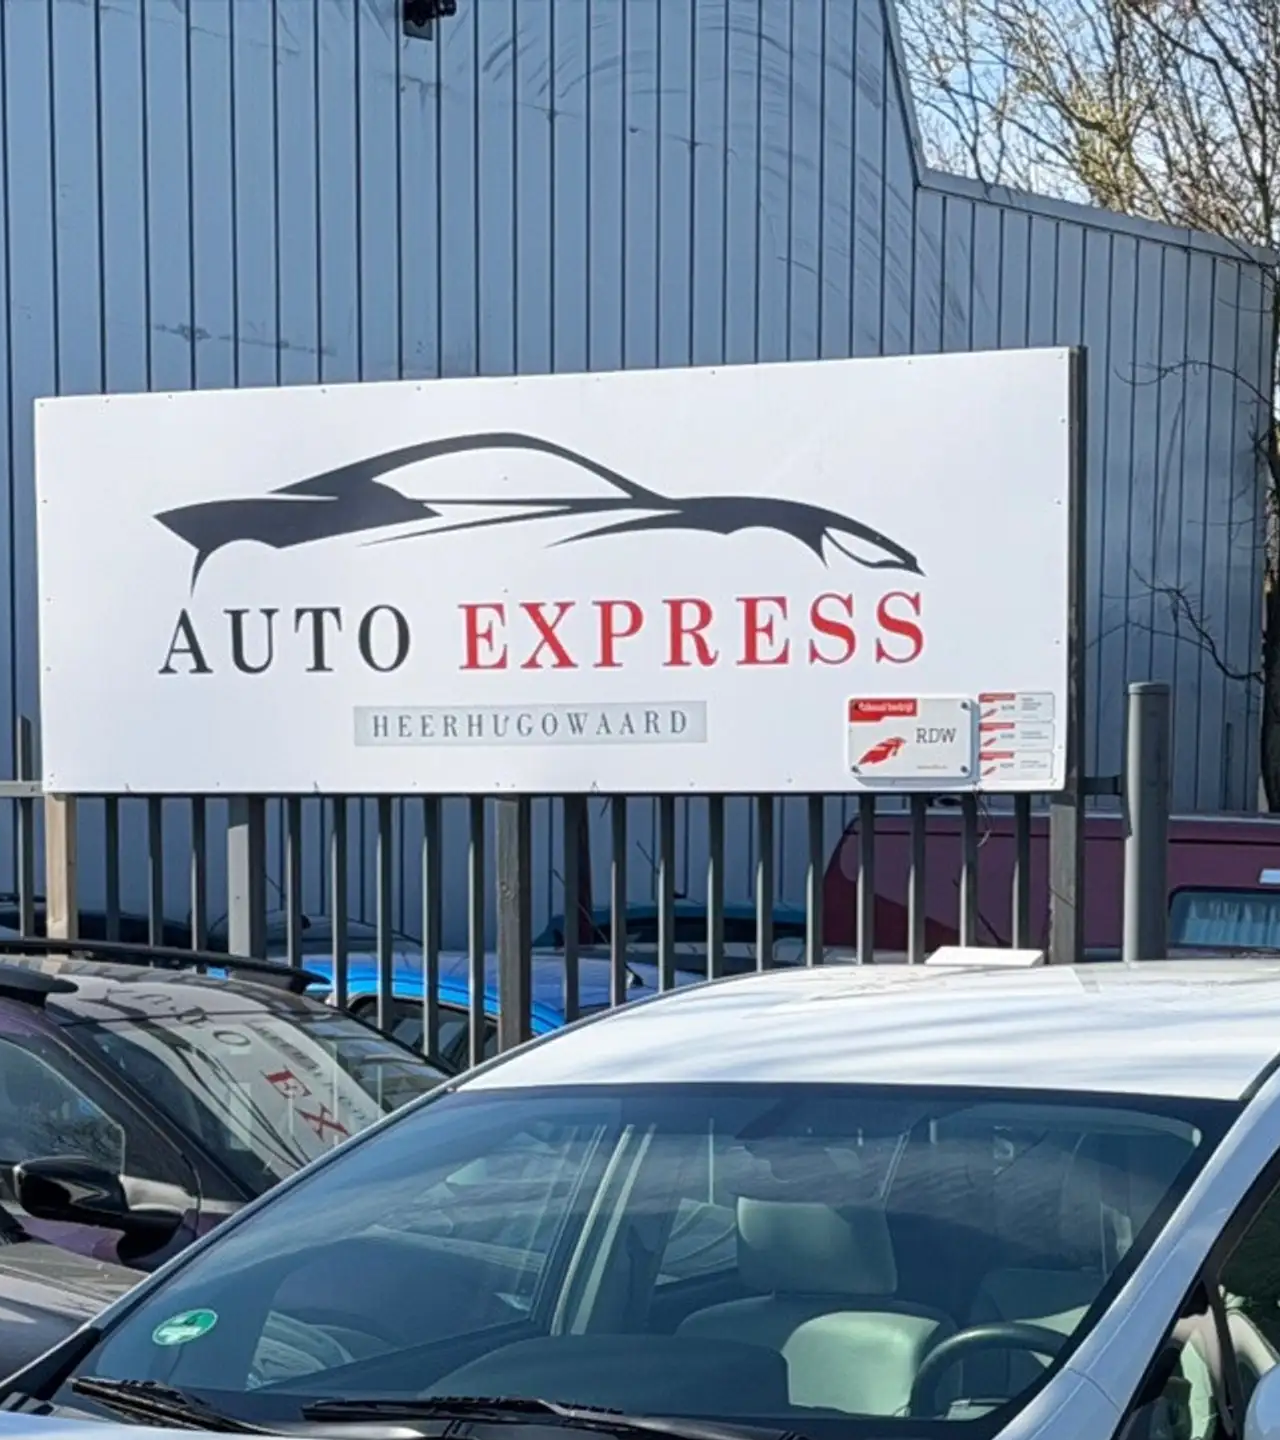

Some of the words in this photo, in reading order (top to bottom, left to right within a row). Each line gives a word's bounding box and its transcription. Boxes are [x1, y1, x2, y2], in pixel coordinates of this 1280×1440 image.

[158, 604, 411, 676] AUTO
[458, 590, 925, 671] EXPRESS
[372, 709, 688, 738] HEERHUGOWAARD
[915, 727, 957, 744] RDW
